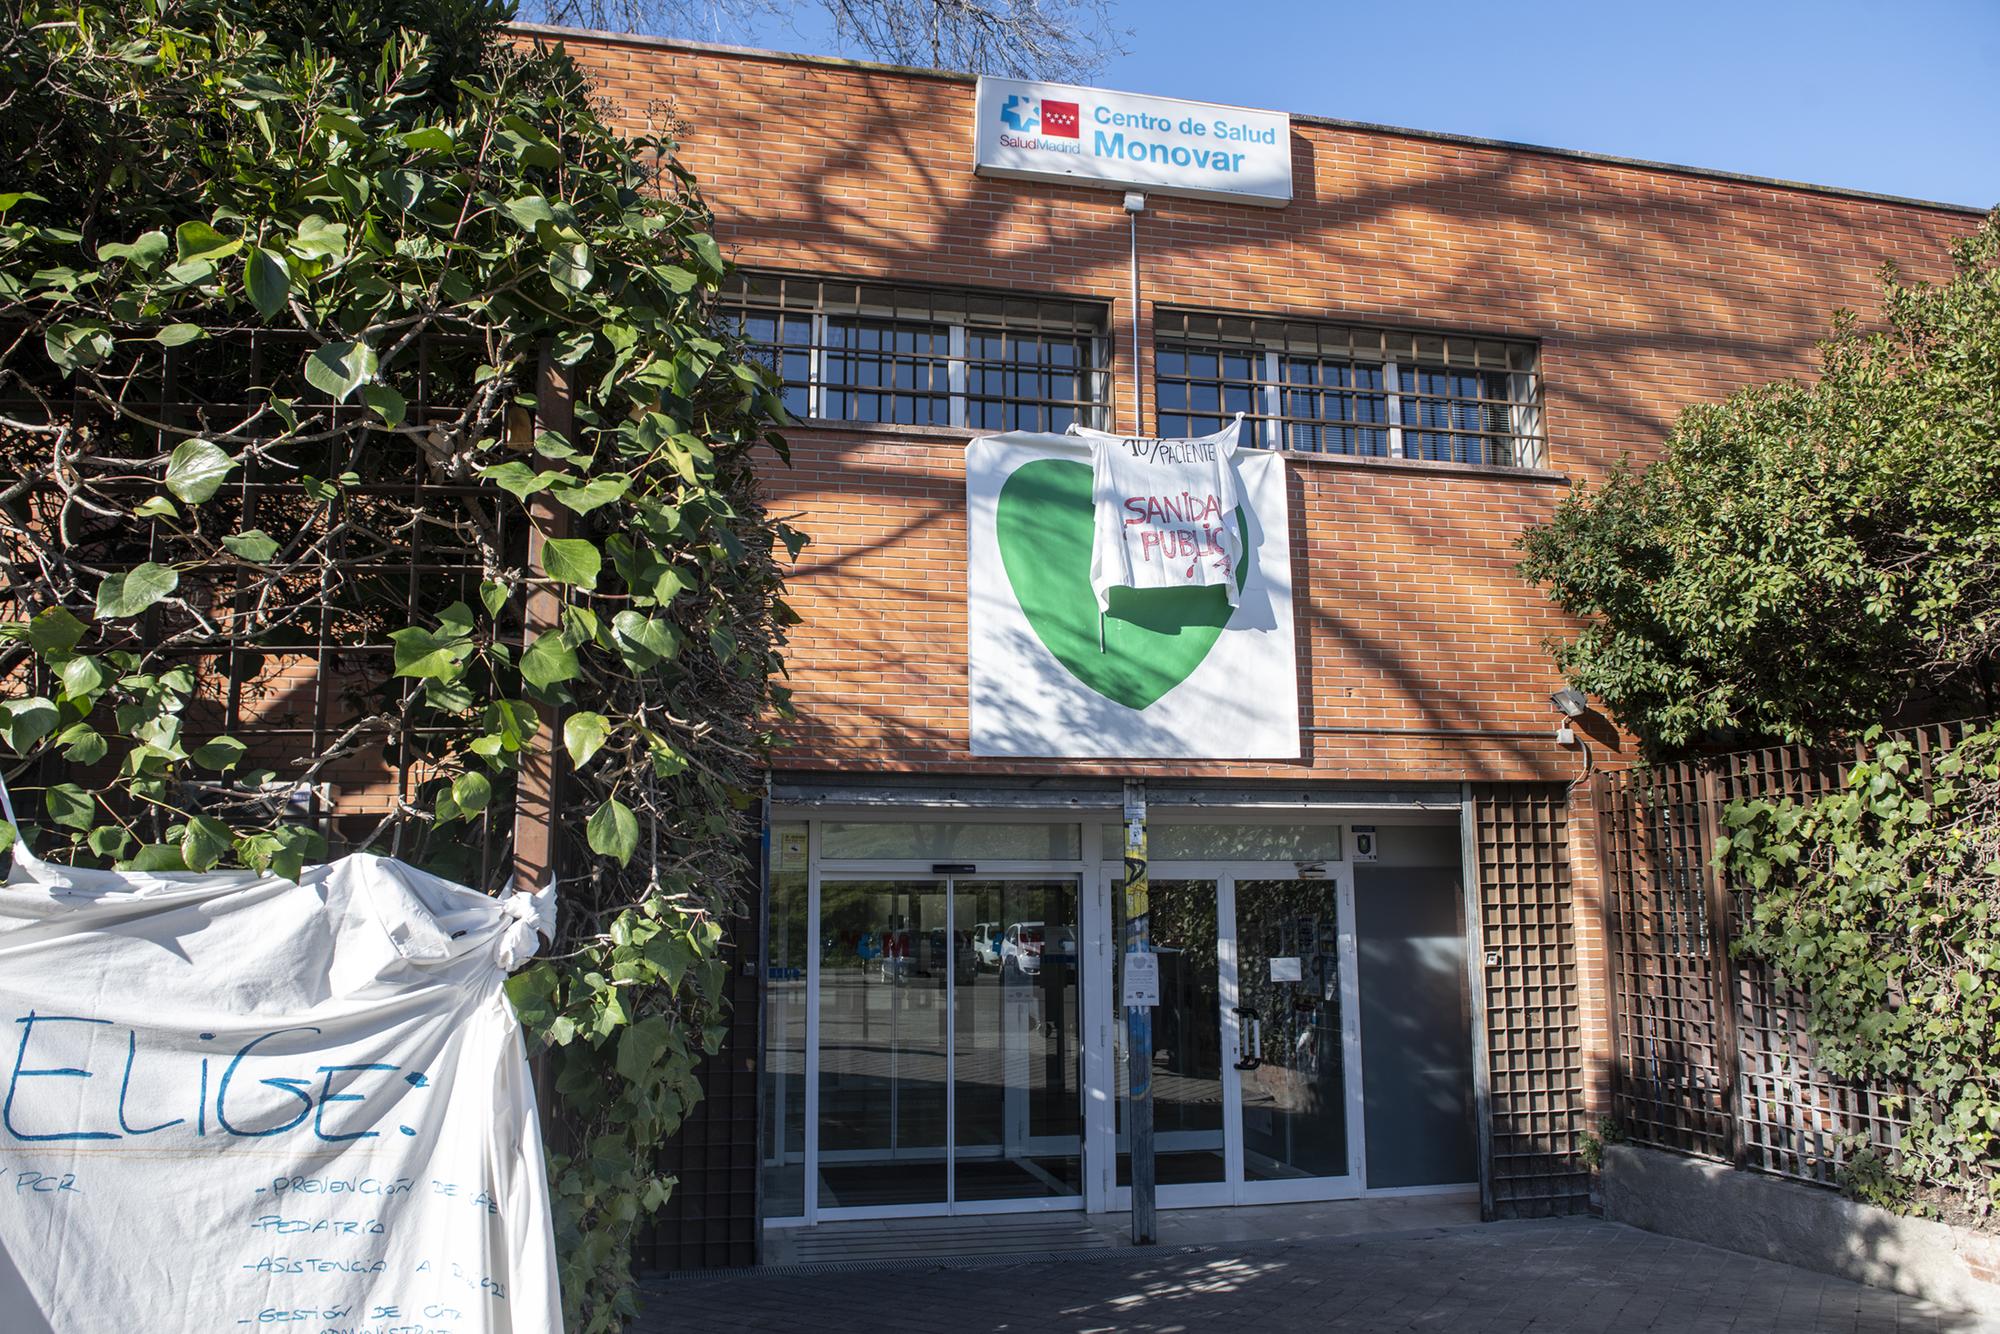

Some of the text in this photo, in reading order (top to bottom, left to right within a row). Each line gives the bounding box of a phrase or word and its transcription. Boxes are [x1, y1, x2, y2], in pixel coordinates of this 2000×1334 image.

[1094, 106, 1275, 146] Centro de Salud
[1000, 134, 1080, 155] SaludMadrid
[1094, 130, 1245, 173] Monovar
[1124, 491, 1223, 525] SANIDA
[16, 1171, 80, 1196] PCR
[370, 1306, 401, 1319] DE
